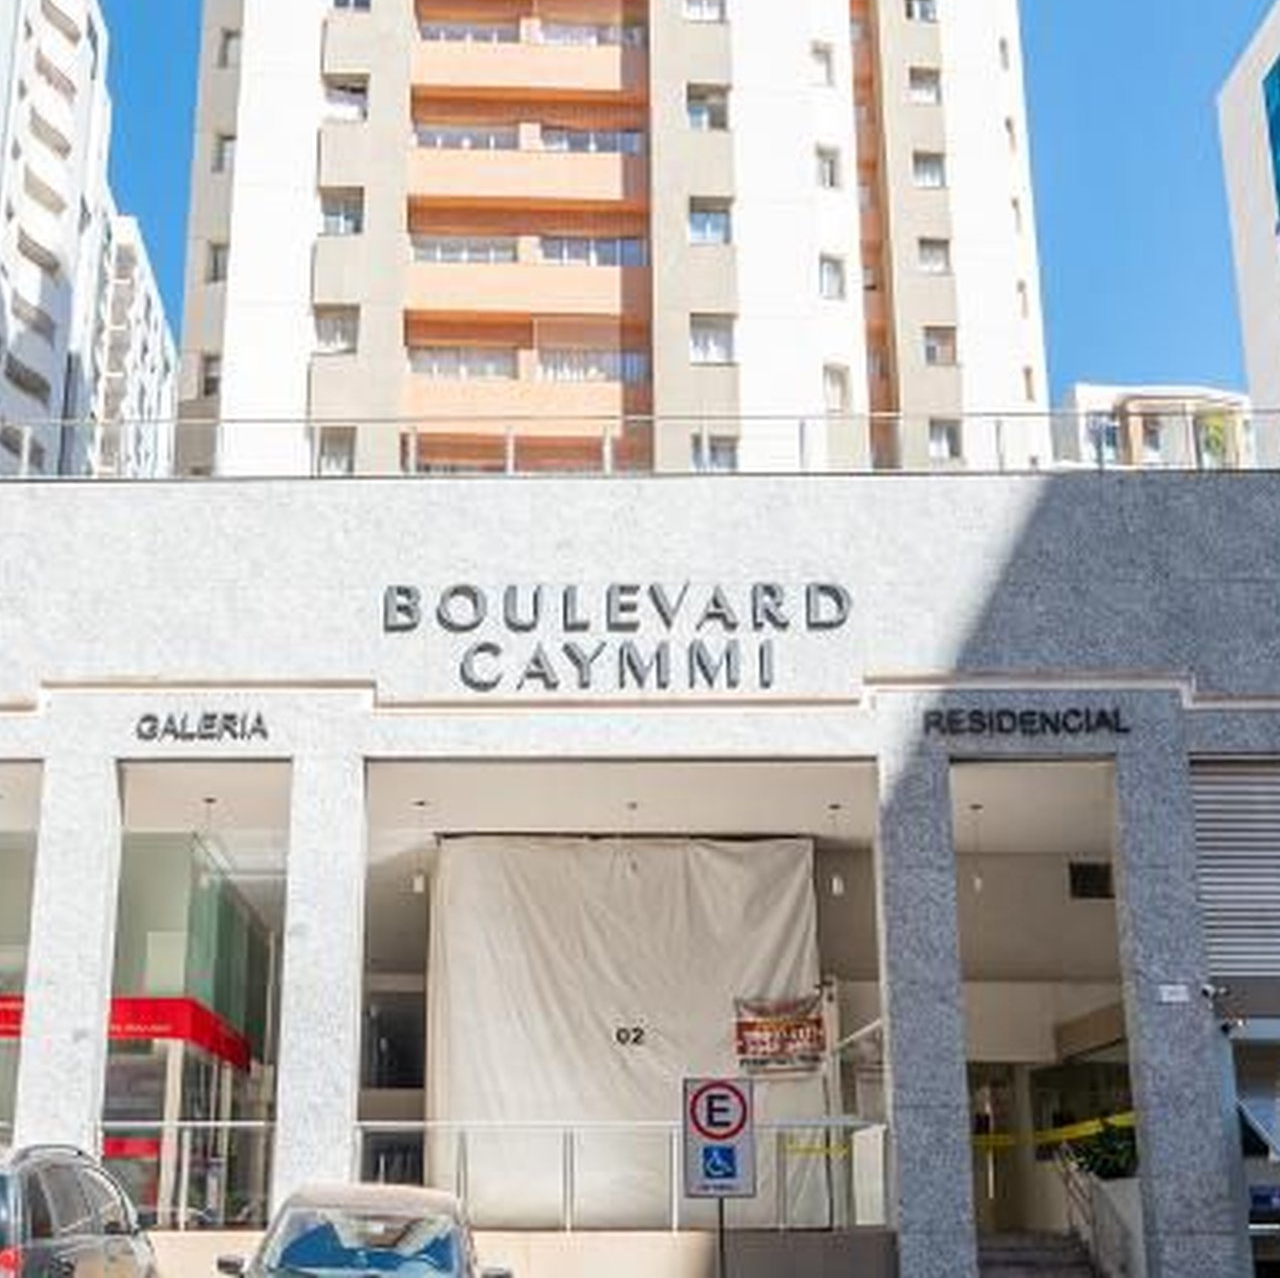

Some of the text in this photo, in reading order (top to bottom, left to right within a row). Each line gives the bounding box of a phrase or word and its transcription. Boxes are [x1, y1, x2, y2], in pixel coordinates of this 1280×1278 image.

[382, 581, 853, 633] BOULEVARD
[459, 639, 775, 691] CAYMMI
[136, 711, 269, 742] GALERIA
[923, 707, 1132, 736] RESIDENCIAL
[616, 1027, 645, 1046] 02
[706, 1094, 731, 1128] E
